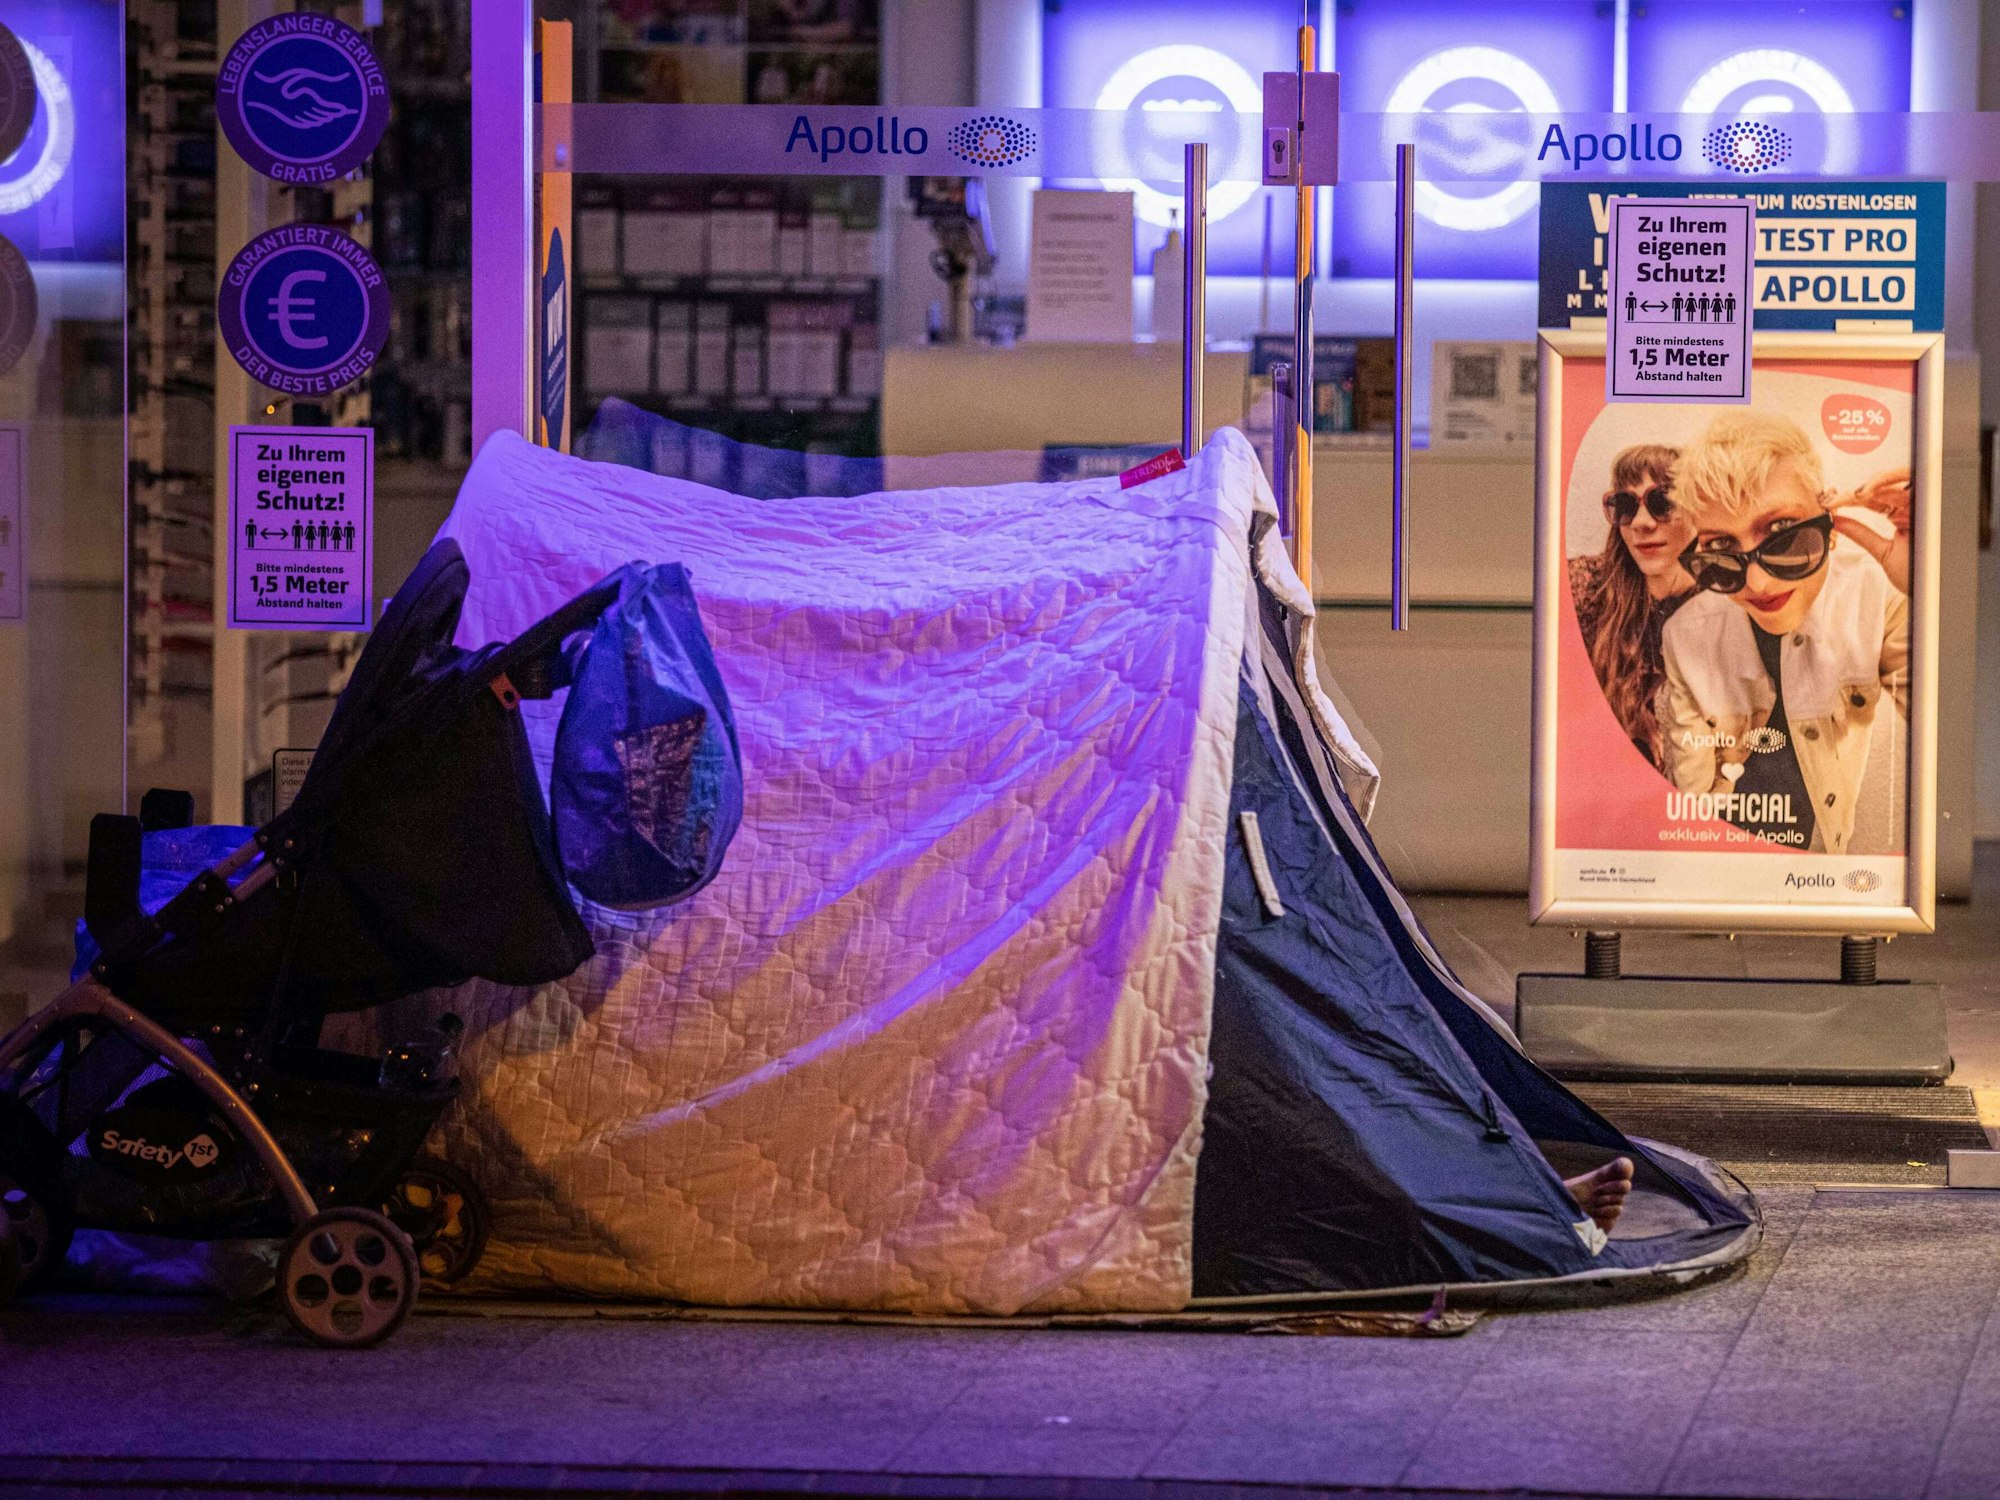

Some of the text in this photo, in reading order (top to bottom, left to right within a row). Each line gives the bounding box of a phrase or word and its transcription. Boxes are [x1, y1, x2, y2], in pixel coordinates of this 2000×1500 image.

[221, 16, 385, 97] LEBENSLANGER SERVICE
[785, 115, 928, 163] Apollo
[1537, 123, 1682, 171] Apollo
[270, 162, 337, 183] GRATIS
[1745, 194, 1784, 210] UM
[1792, 194, 1917, 210] KOSTENLOSEN
[1638, 216, 1727, 233] Zu Ihrem
[1638, 236, 1726, 261] eigenen
[1759, 228, 1907, 252] TEST PRO
[228, 227, 382, 289] GARANTIERT IMMER
[1637, 262, 1726, 283] Schutz!
[1761, 275, 1905, 302] APOLLO
[1636, 336, 1724, 346] Bitte mindestens
[236, 346, 375, 393] DER BESTE PREIS
[1629, 348, 1729, 370] 1,5 Meter
[1636, 371, 1722, 381] Abstand halten
[257, 445, 345, 462] Zu Ihrem
[257, 464, 345, 489] eigenen
[256, 490, 345, 511] Schutz!
[256, 563, 344, 574] Bitte mindestens
[250, 575, 349, 596] 1,5 Meter
[256, 598, 342, 609] Abstand halten
[1681, 731, 1736, 749] Apollo
[1666, 791, 1797, 823] UNOFFICIAL
[1658, 828, 1805, 845] exklusiv bei Apollo
[1785, 872, 1836, 890] Apollo
[101, 1130, 214, 1169] Safety 1st
